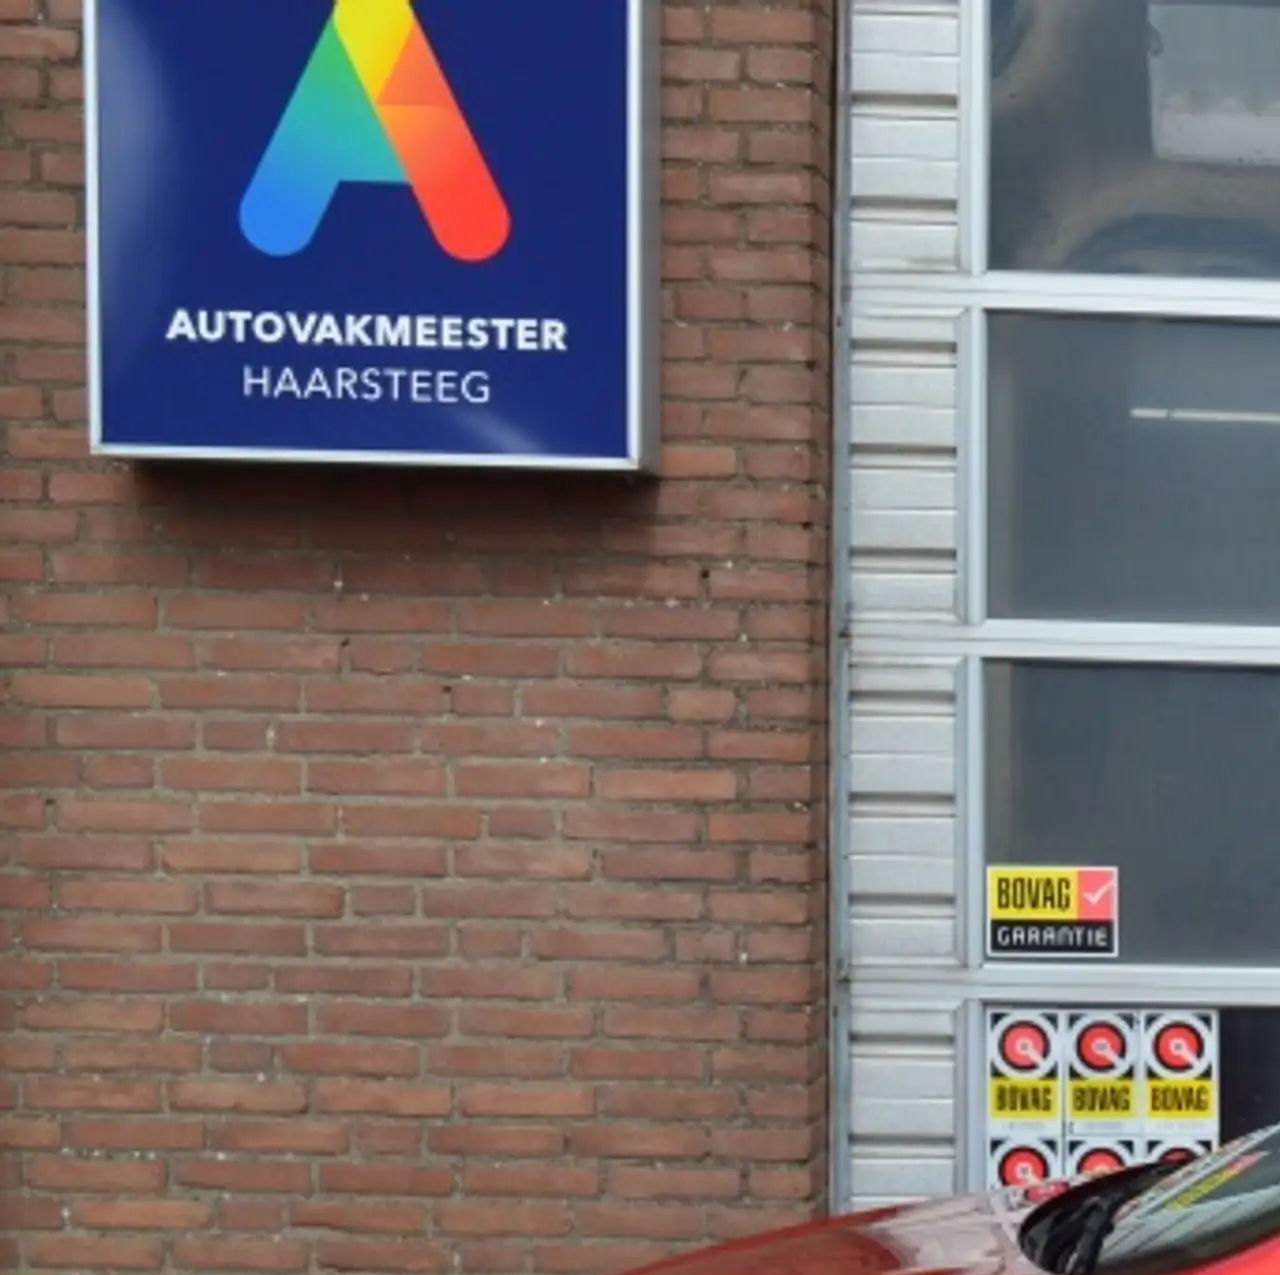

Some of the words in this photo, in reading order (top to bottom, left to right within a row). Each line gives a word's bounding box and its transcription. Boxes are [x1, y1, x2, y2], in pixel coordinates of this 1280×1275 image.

[166, 309, 568, 351] AUTOVAKMEESTER
[242, 366, 491, 403] HAARSTEEG
[996, 877, 1072, 911] BOVAG
[997, 926, 1107, 947] GARANTIE
[997, 1086, 1052, 1111] BOVAG
[1073, 1086, 1131, 1111] BOVAG
[1150, 1086, 1209, 1111] BOVAG
